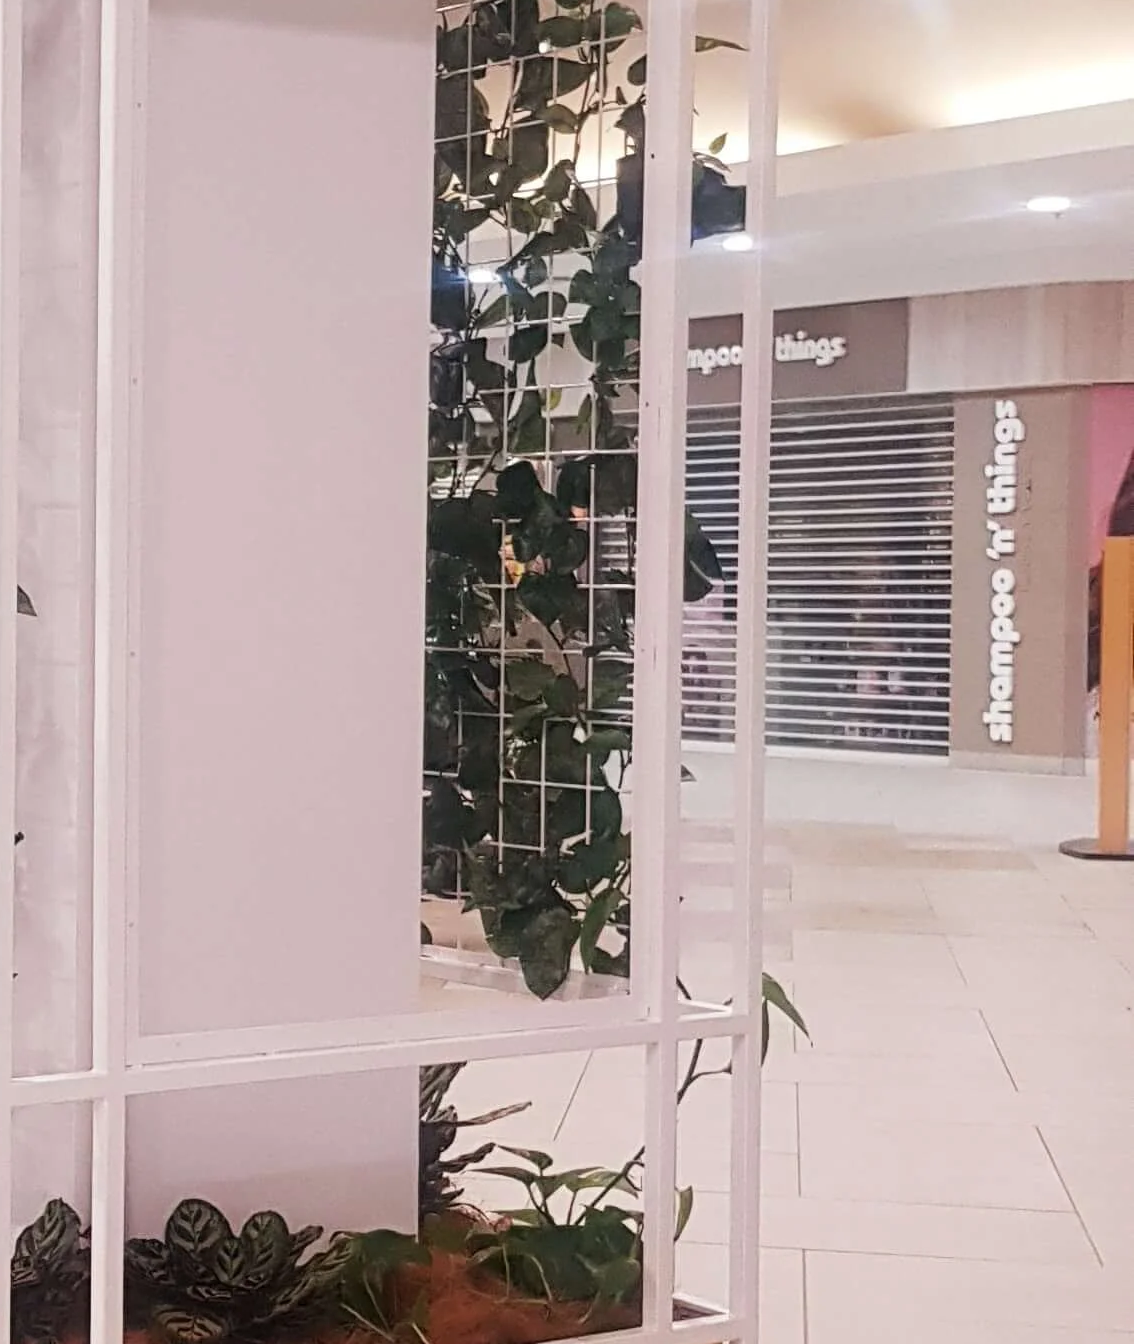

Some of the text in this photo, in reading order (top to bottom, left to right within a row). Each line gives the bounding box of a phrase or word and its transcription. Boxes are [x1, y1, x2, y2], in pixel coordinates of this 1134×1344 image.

[688, 330, 847, 375] mpoo things
[984, 400, 1026, 514] things
[982, 568, 1021, 743] shampoo
